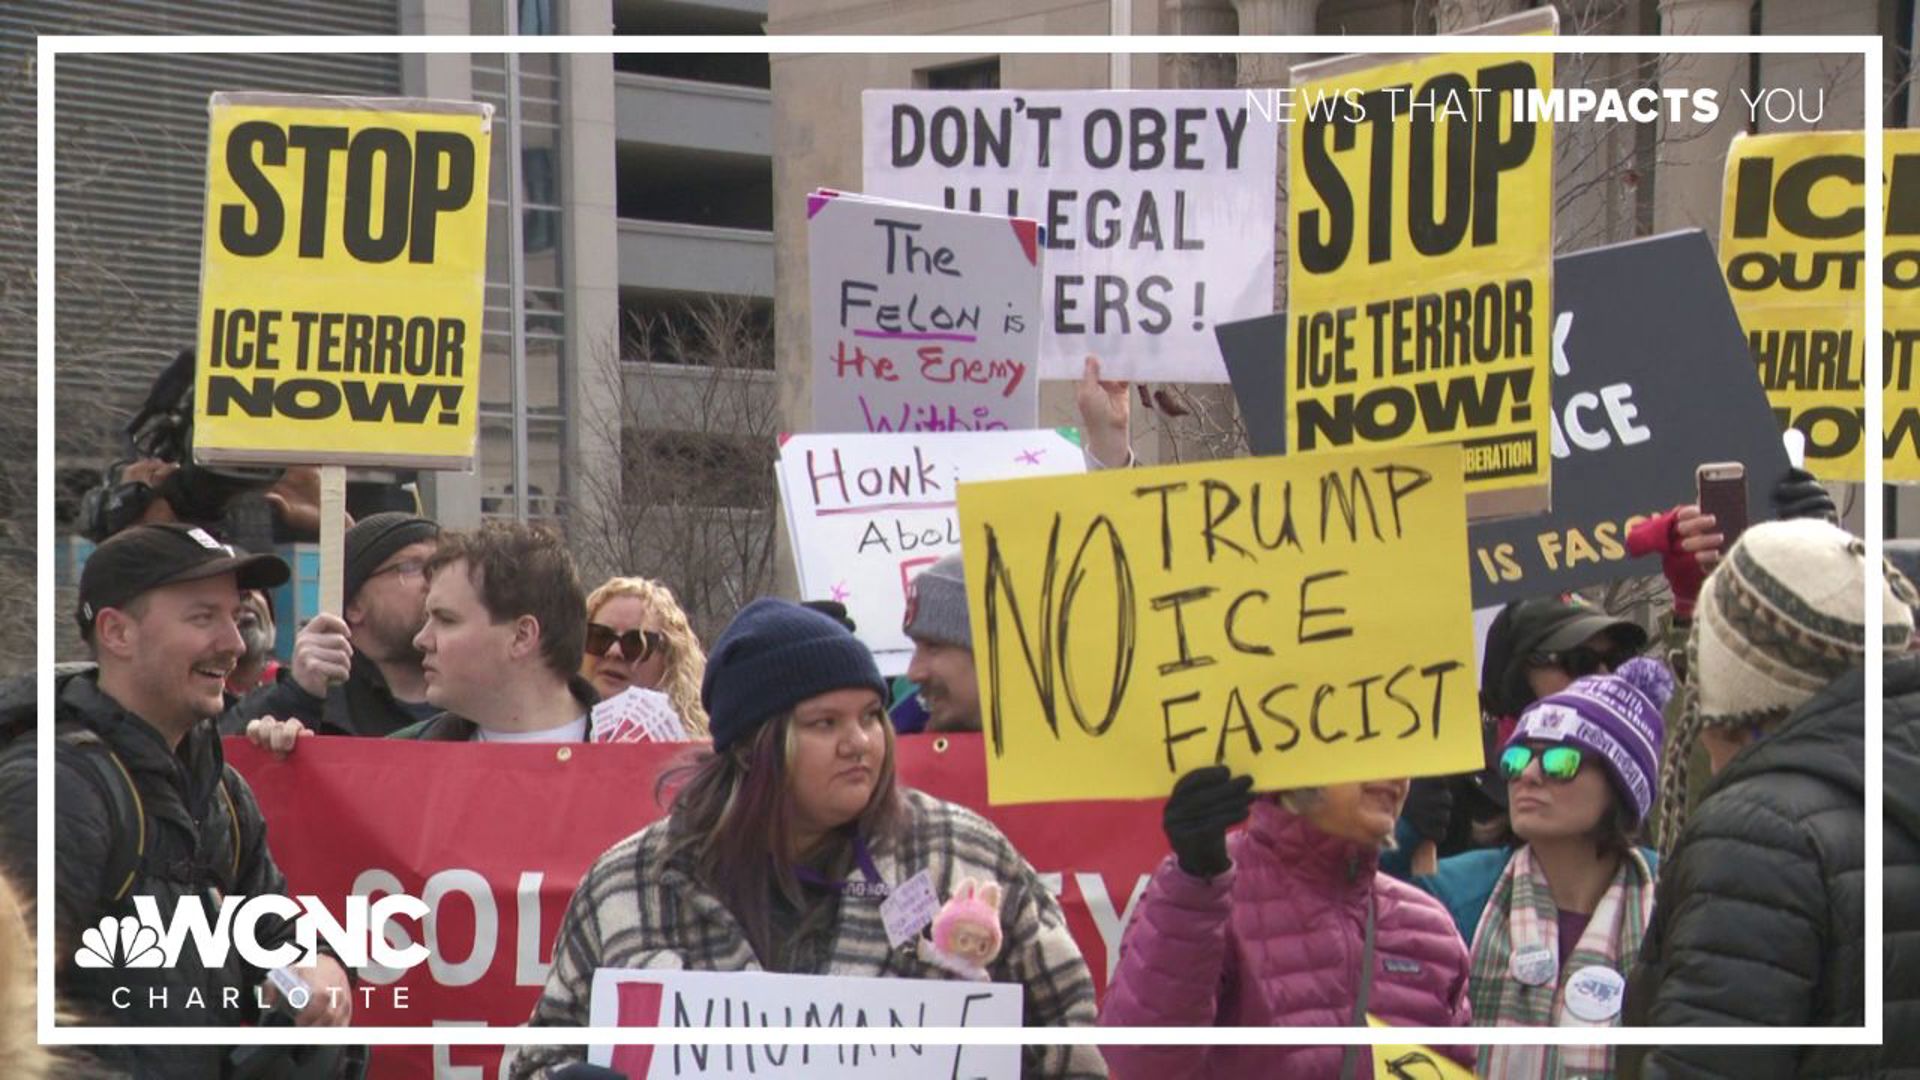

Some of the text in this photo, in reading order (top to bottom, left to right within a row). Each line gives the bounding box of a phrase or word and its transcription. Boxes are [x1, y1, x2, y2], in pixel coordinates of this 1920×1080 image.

[891, 97, 1248, 171] DON'T OBEY
[1298, 60, 1538, 275] STOP
[219, 120, 475, 264] STOP
[873, 218, 962, 277] The
[209, 308, 466, 377] ICE TERROR
[1004, 301, 1025, 334] is
[1297, 278, 1534, 390] ICE TERROR
[206, 376, 464, 425] NOW!
[916, 346, 1025, 398] Enemy
[1297, 367, 1535, 451] NOW!
[1132, 464, 1432, 571] TRUMP
[1477, 543, 1523, 584] IS
[984, 513, 1136, 758] NO
[1150, 569, 1353, 674] ICE
[1160, 660, 1463, 772] FASCIST
